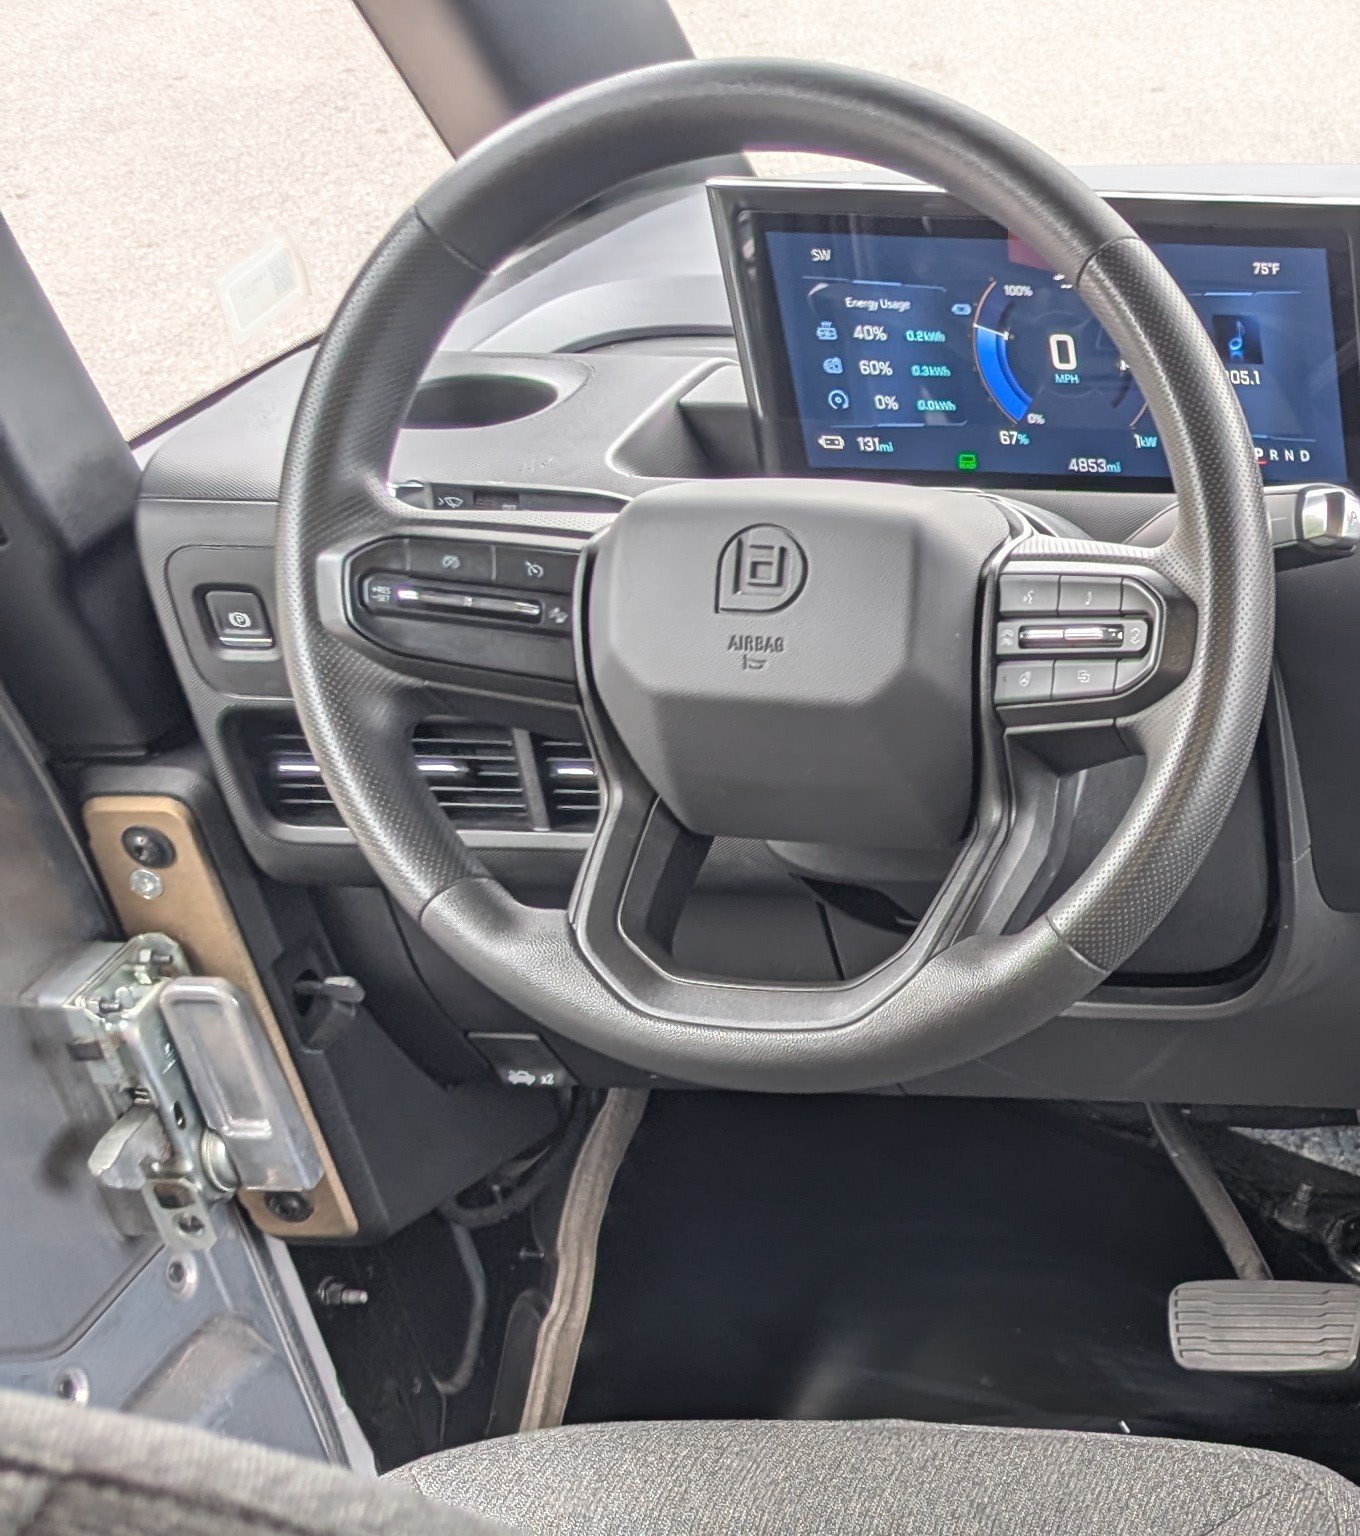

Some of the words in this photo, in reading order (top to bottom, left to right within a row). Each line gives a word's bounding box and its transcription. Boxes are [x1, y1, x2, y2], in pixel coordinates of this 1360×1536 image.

[810, 248, 832, 262] SW
[1003, 284, 1034, 297] 100%
[845, 296, 879, 312] Energy
[880, 298, 912, 313] Usage
[853, 324, 888, 341] 40%
[1049, 333, 1078, 371] 0
[859, 359, 894, 376] 60%
[1054, 373, 1080, 385] MPH
[874, 394, 899, 411] 0%
[1026, 412, 1046, 426] 0%
[999, 430, 1031, 446] 67%
[1269, 449, 1280, 461] R
[1284, 450, 1295, 462] N
[1300, 450, 1311, 462] D
[728, 634, 785, 653] AIRBAG
